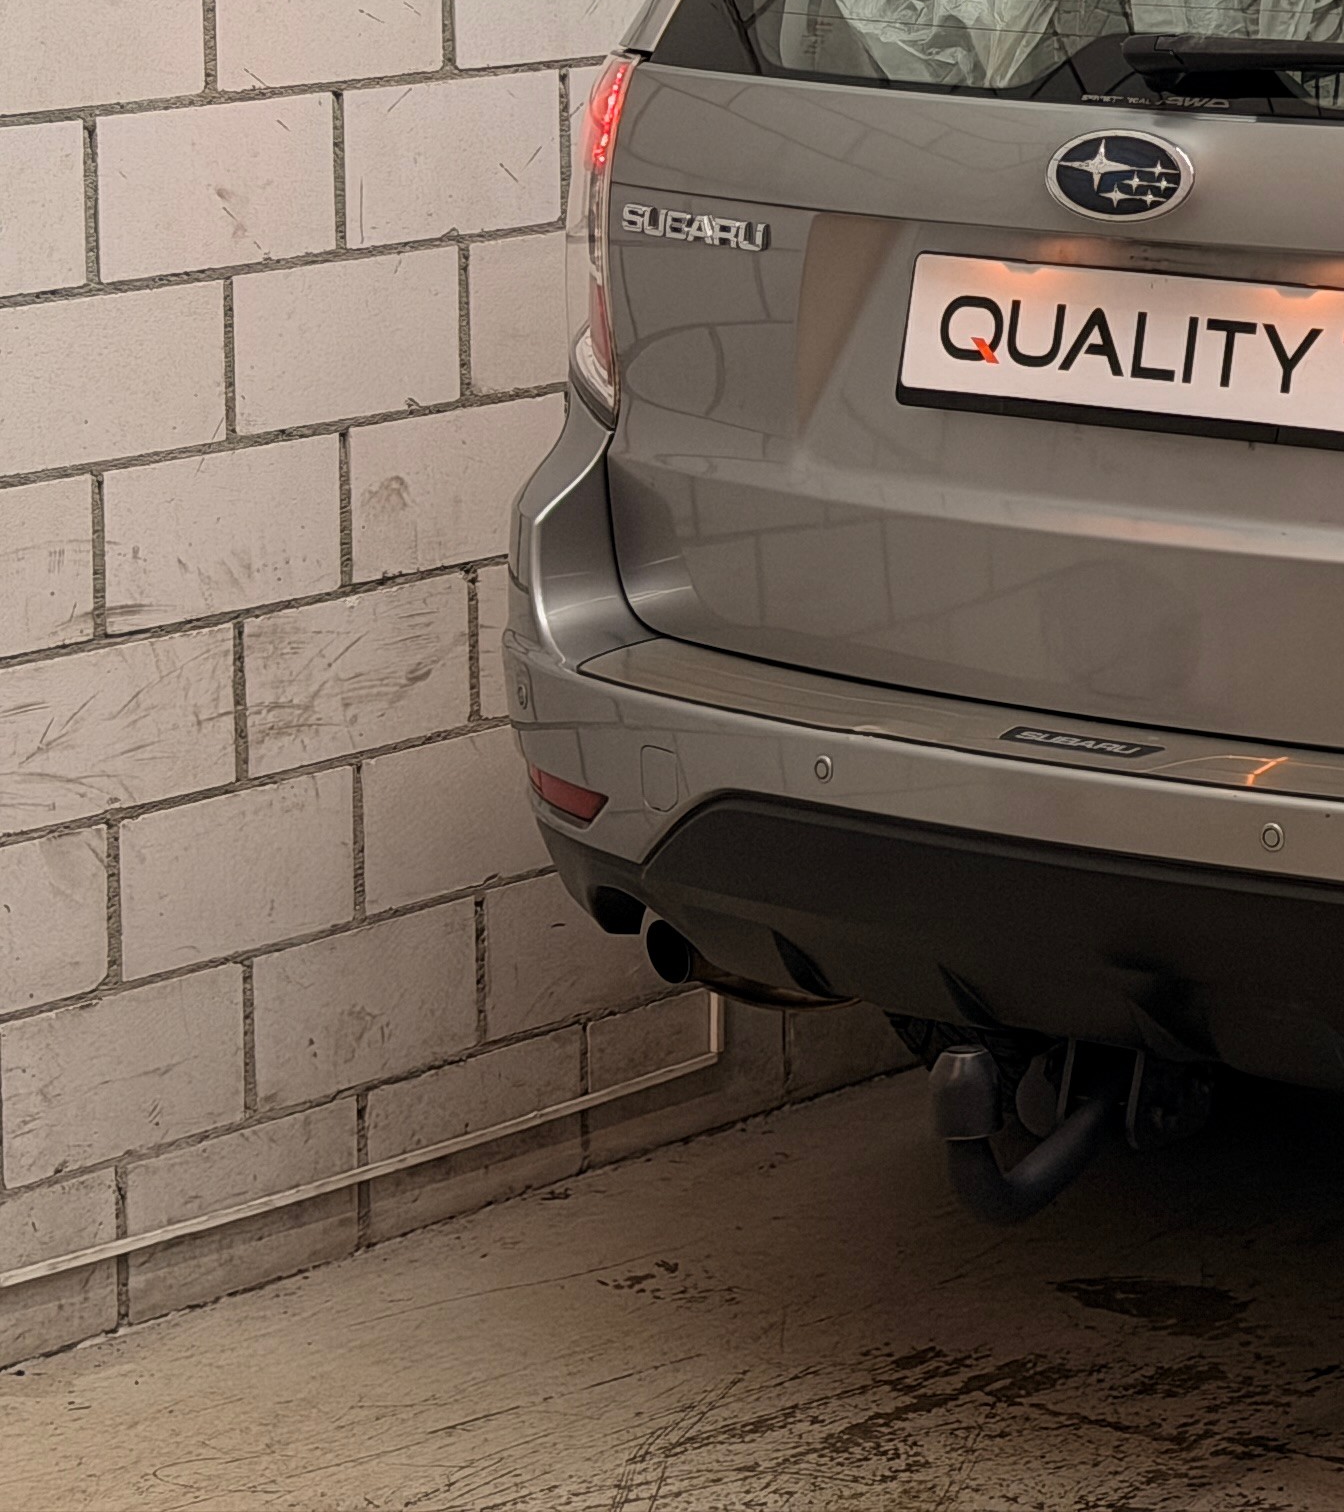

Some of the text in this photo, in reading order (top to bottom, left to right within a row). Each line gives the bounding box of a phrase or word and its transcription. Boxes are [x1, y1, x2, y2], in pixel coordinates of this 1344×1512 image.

[621, 203, 772, 251] SUBARU
[939, 294, 1325, 394] QUALITY
[1015, 730, 1142, 755] SUBARU
